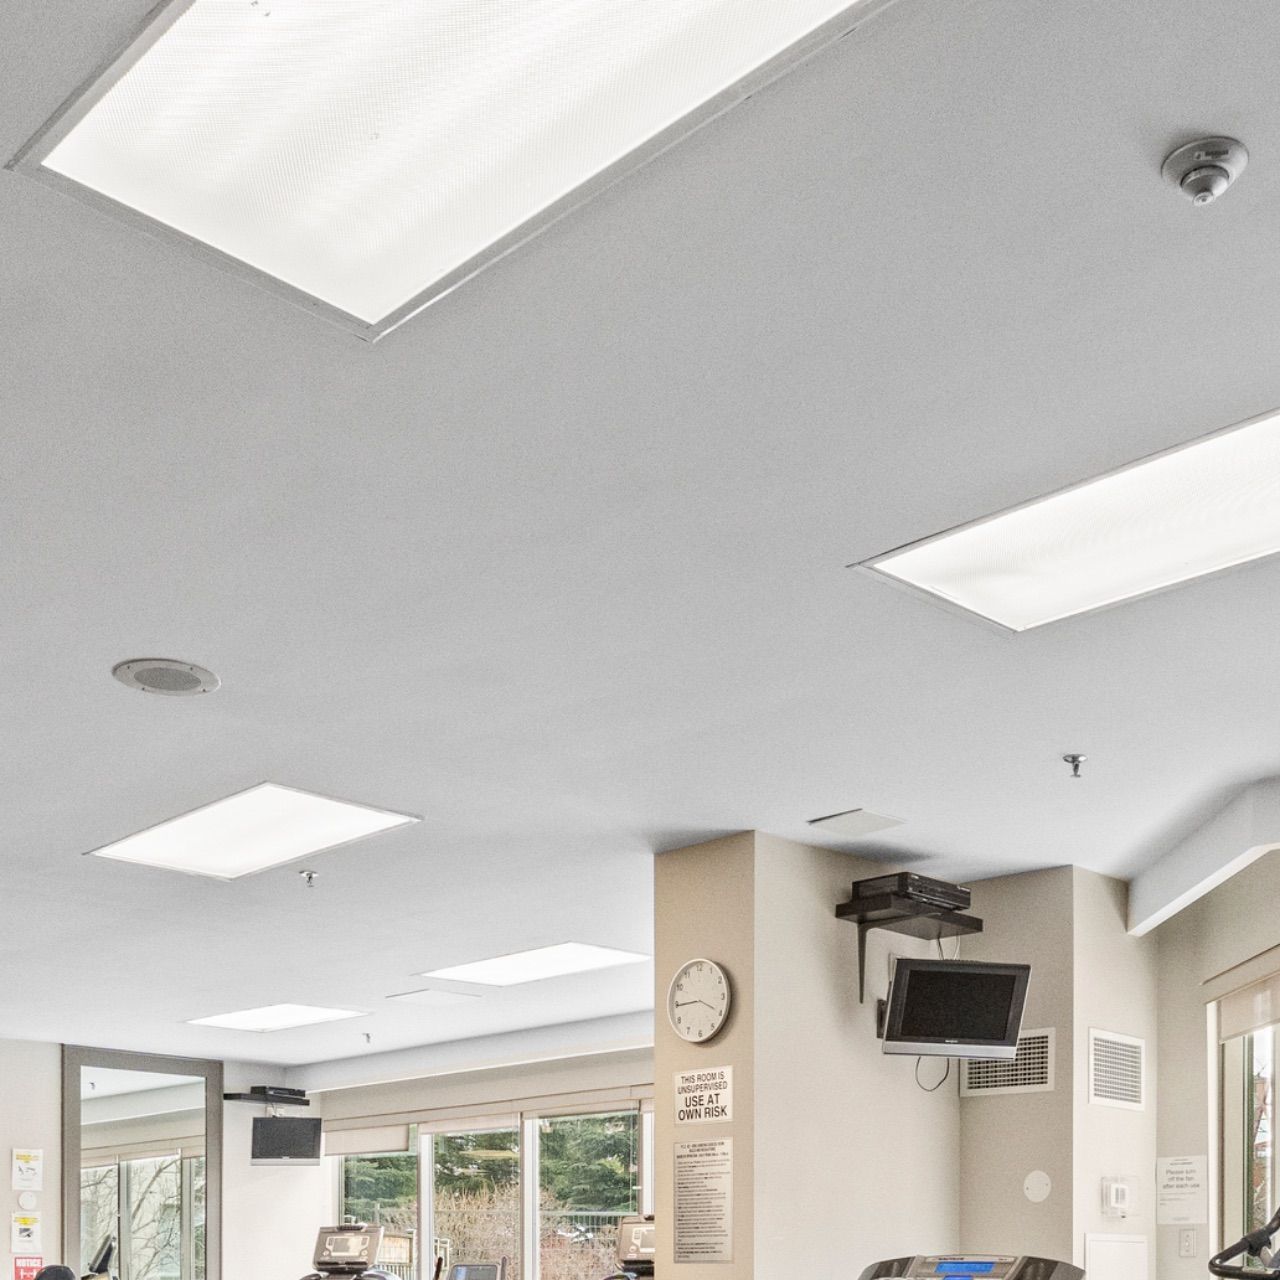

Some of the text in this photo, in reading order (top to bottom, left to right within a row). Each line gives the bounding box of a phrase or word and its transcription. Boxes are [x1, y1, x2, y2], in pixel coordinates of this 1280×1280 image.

[696, 963, 704, 972] 12
[697, 1029, 703, 1038] 6
[681, 1071, 725, 1084] THIS ROOM IS
[677, 1081, 728, 1094] UNSUPERVISED
[685, 1093, 720, 1108] USE AT
[678, 1105, 728, 1121] OWN RISK
